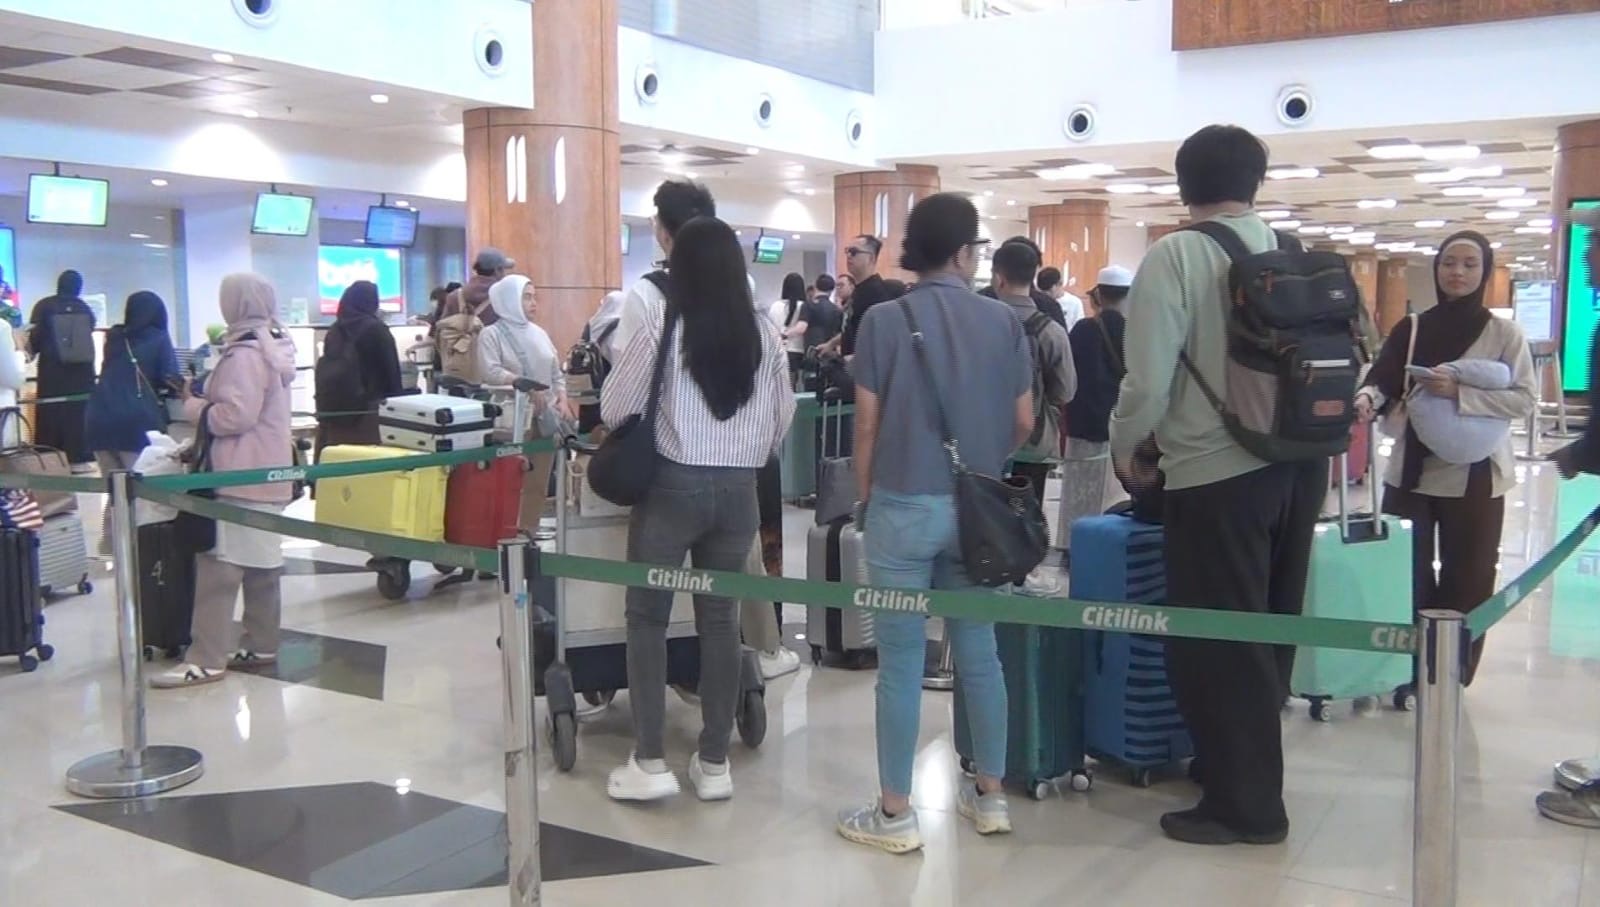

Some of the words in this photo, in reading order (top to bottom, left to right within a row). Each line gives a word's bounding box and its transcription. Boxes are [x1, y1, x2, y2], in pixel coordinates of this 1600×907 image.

[647, 567, 714, 592] Citilink
[853, 585, 931, 613] Citilink
[1081, 605, 1170, 632] Citilink
[1370, 626, 1418, 650] Citi
